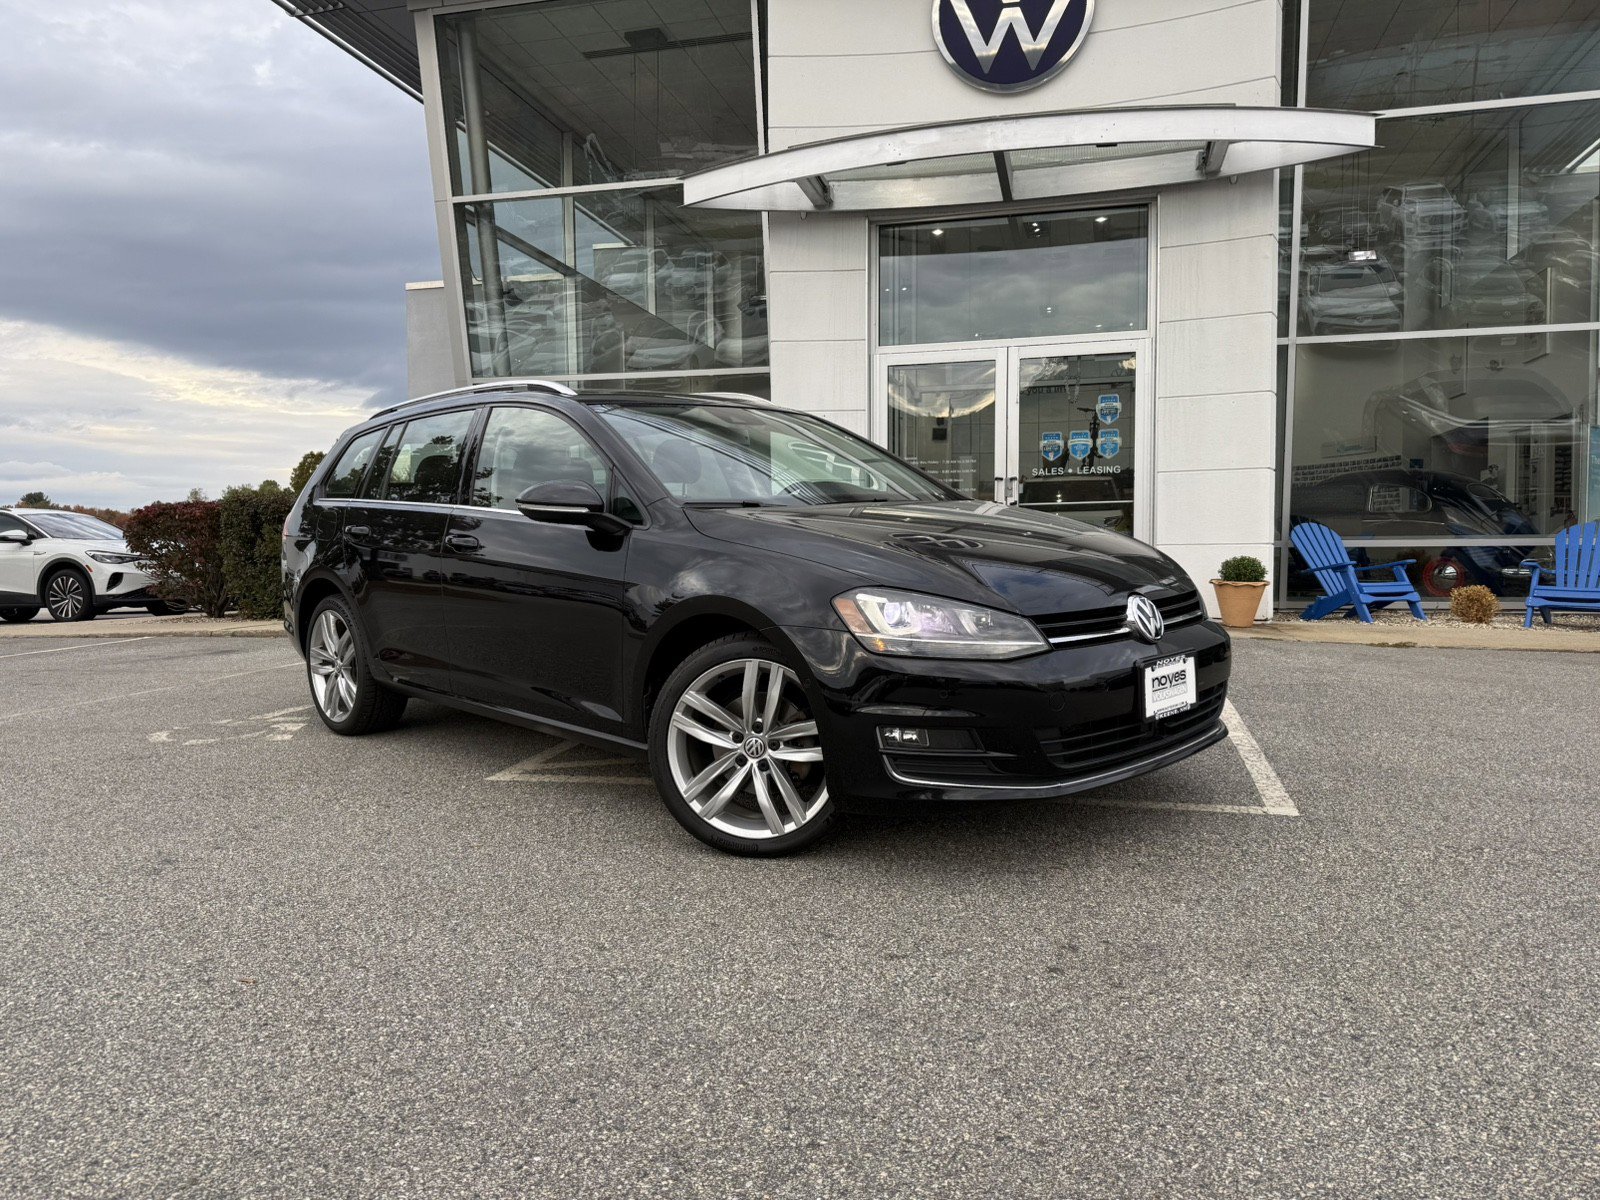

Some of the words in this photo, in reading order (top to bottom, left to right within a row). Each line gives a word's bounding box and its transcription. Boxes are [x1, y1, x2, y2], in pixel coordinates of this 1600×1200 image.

[1031, 467, 1064, 476] SALES
[1076, 465, 1121, 475] LEASING
[1152, 670, 1187, 688] noyes
